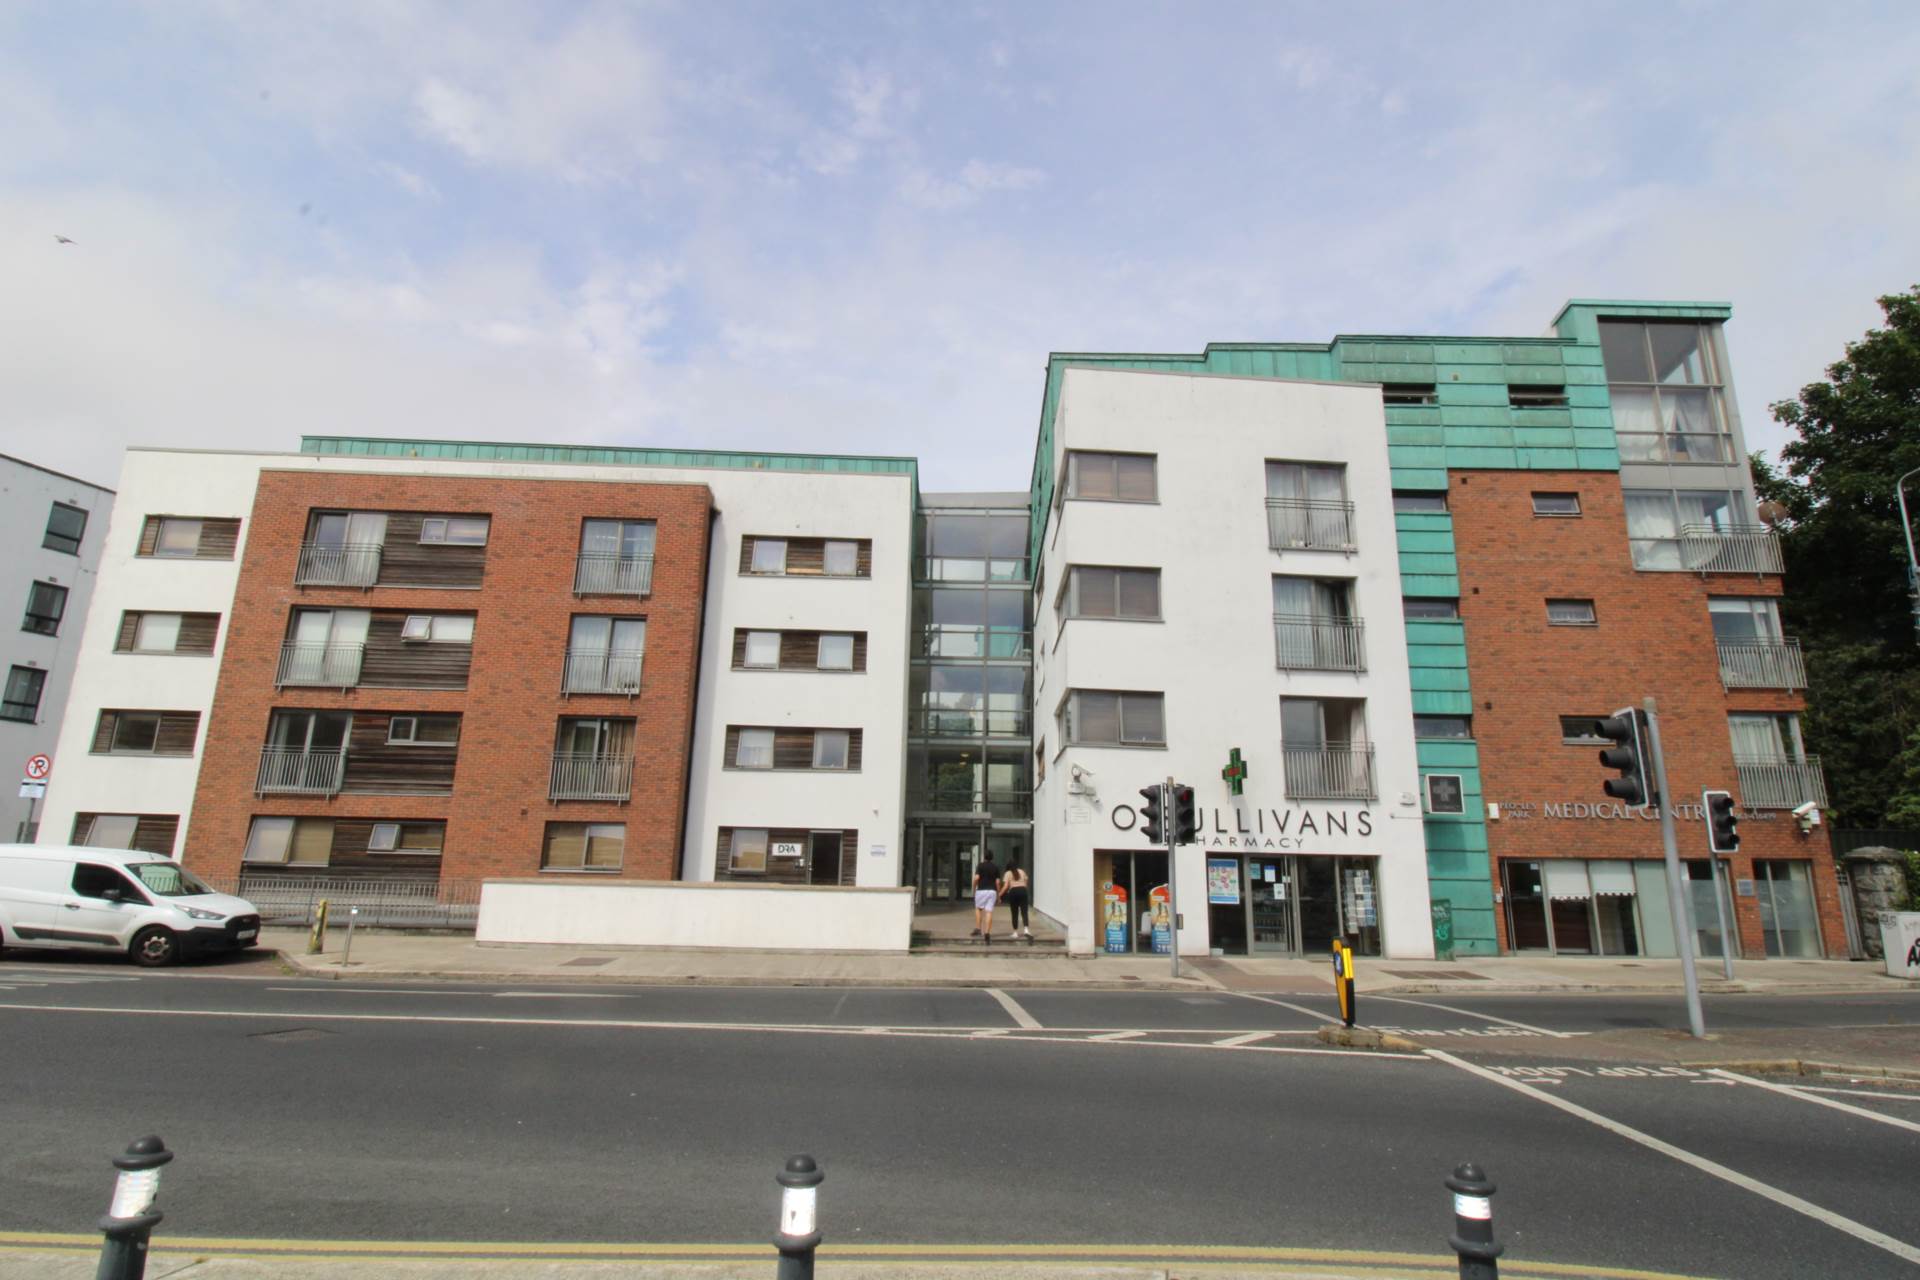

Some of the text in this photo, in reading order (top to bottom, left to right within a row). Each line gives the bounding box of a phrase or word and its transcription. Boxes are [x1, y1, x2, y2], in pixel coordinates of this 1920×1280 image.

[1543, 801, 1706, 820] MEDICAL CENTR
[1195, 835, 1304, 848] HARMACY
[1485, 1066, 1701, 1077] STOP LOOK
